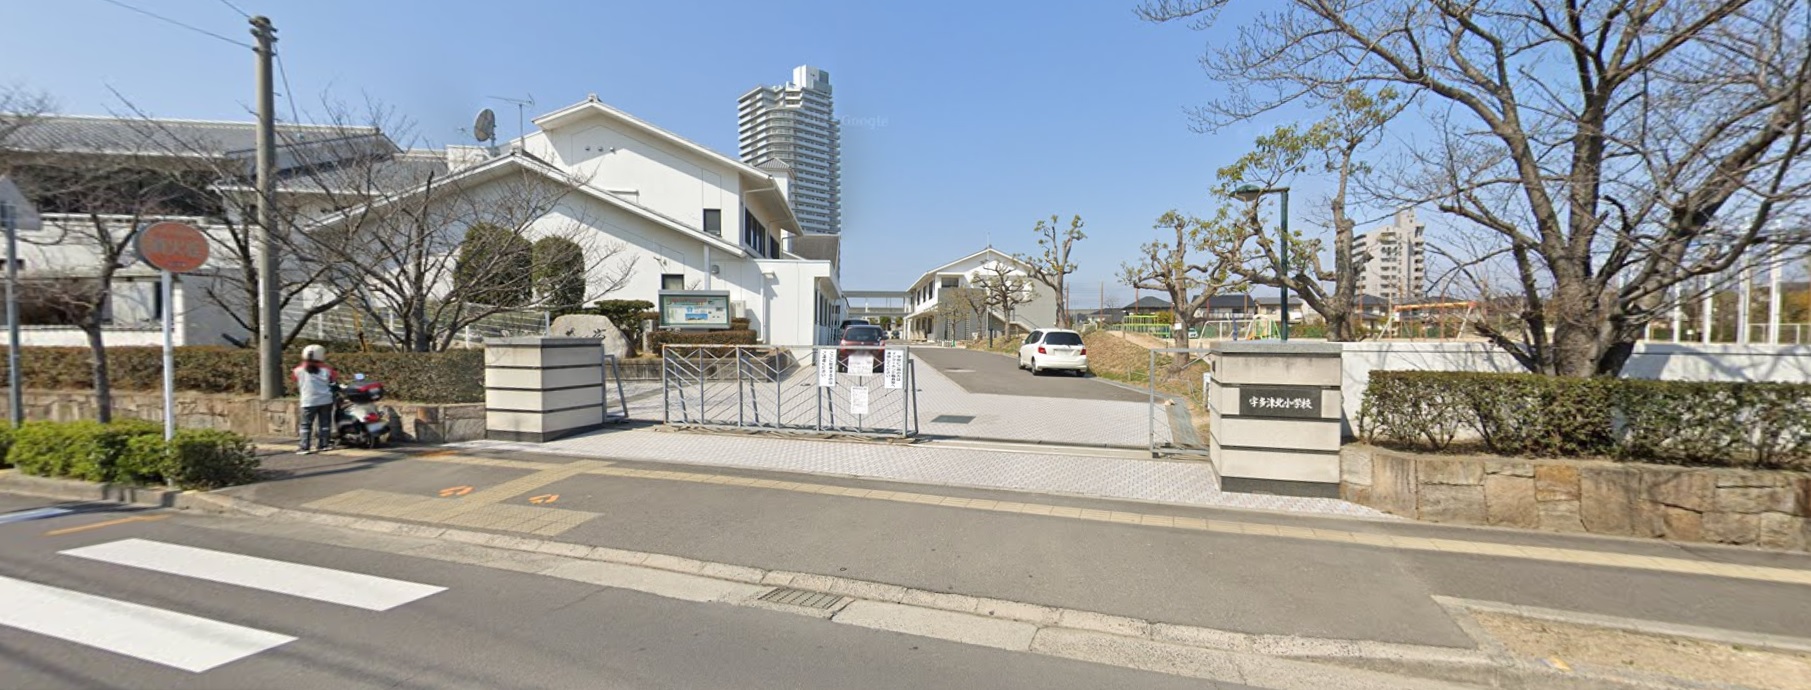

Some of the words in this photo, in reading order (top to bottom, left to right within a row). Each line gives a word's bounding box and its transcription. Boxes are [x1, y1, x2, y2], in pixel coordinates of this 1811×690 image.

[1249, 396, 1313, 409] 宇多津北小学校
